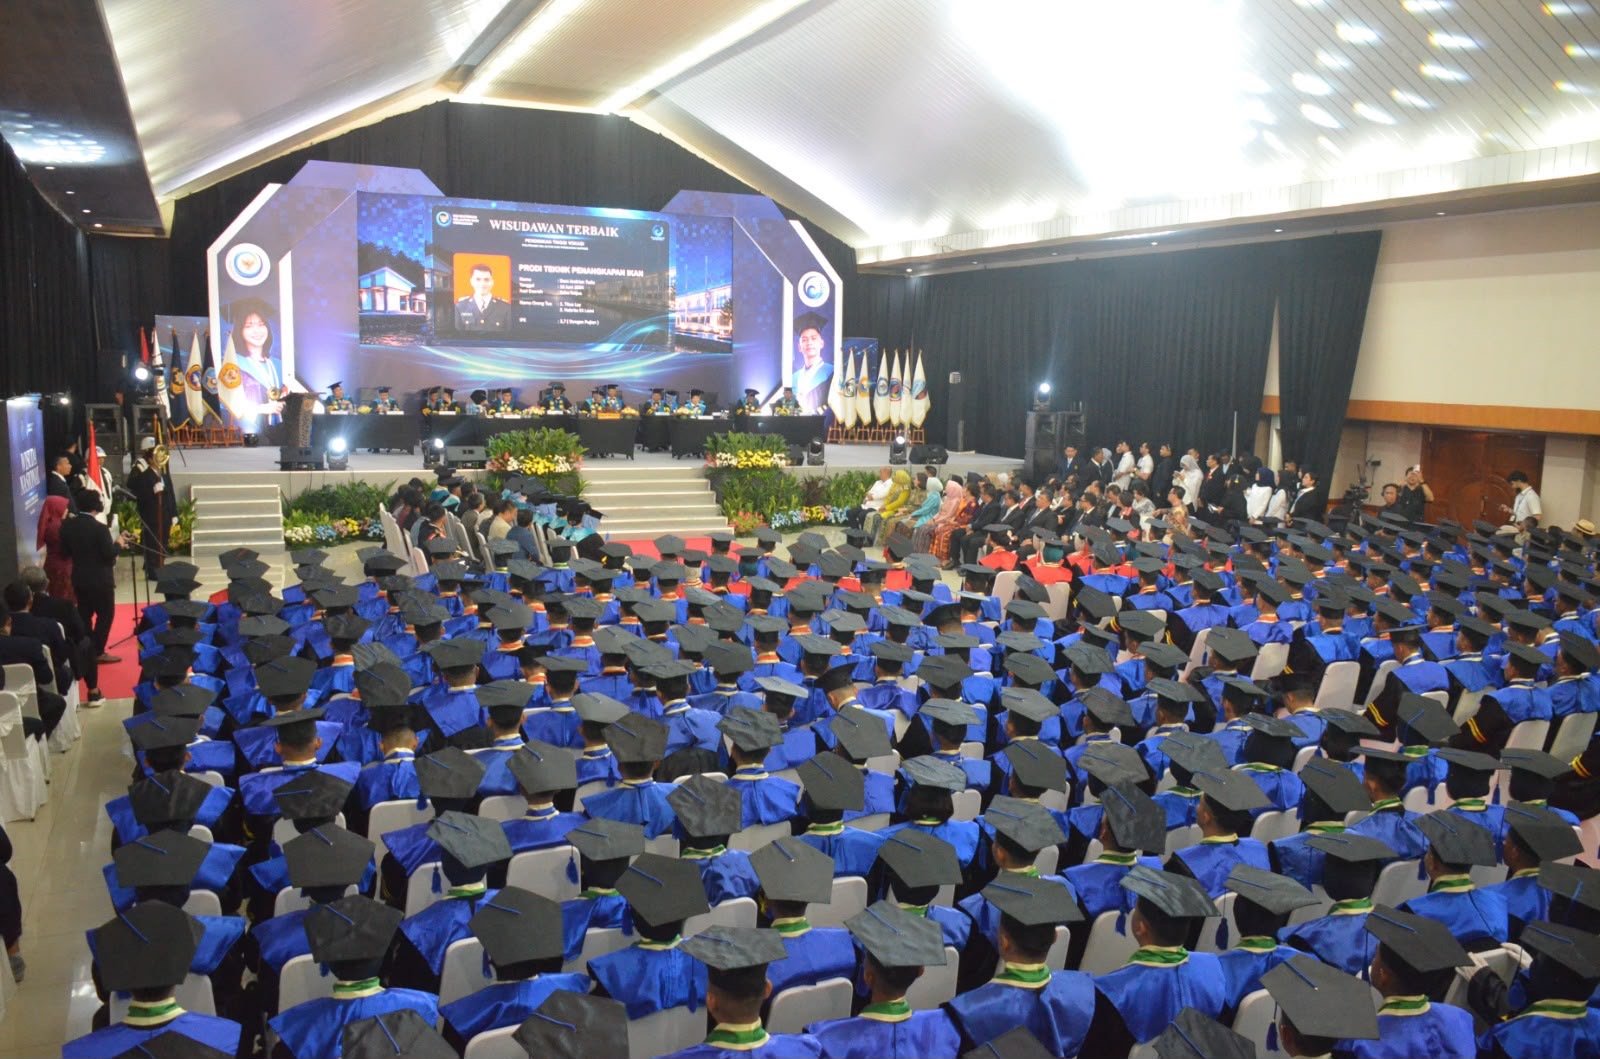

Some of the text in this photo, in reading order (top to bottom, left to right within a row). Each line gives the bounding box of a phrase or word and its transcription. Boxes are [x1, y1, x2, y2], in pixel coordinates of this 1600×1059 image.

[489, 219, 564, 234] WISUDAWAN
[565, 224, 619, 238] TERBAIK
[518, 264, 644, 277] PRODI TEKNIK PENANGKAPAN IKAN
